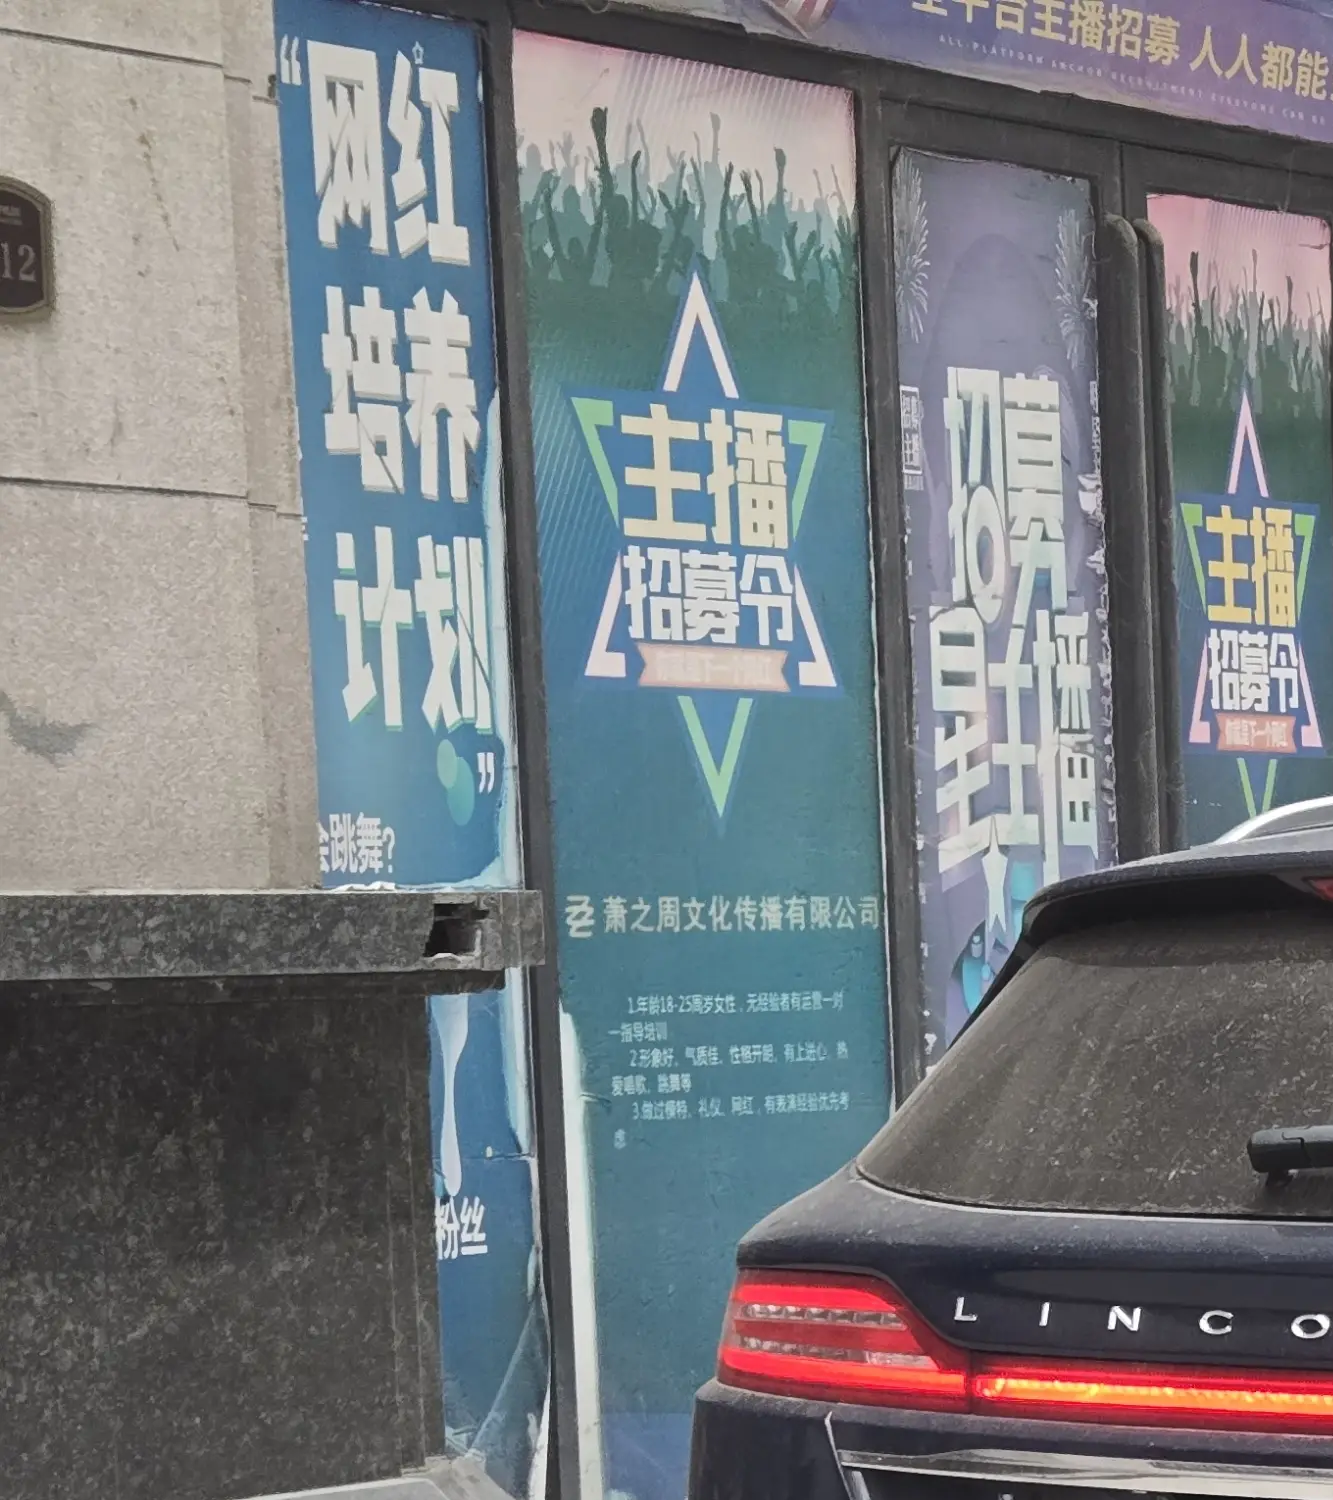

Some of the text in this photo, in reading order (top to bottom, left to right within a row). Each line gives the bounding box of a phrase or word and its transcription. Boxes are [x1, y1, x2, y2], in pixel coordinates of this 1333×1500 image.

[321, 283, 482, 504] 培养
[620, 403, 789, 550] 主播
[943, 367, 1068, 626] 招募
[623, 545, 795, 646] 招募令
[1205, 504, 1297, 629] 主播
[1207, 628, 1300, 713] 招募令
[603, 895, 881, 934] 萧之周文化传播有限公司
[434, 1196, 489, 1260] 粉丝
